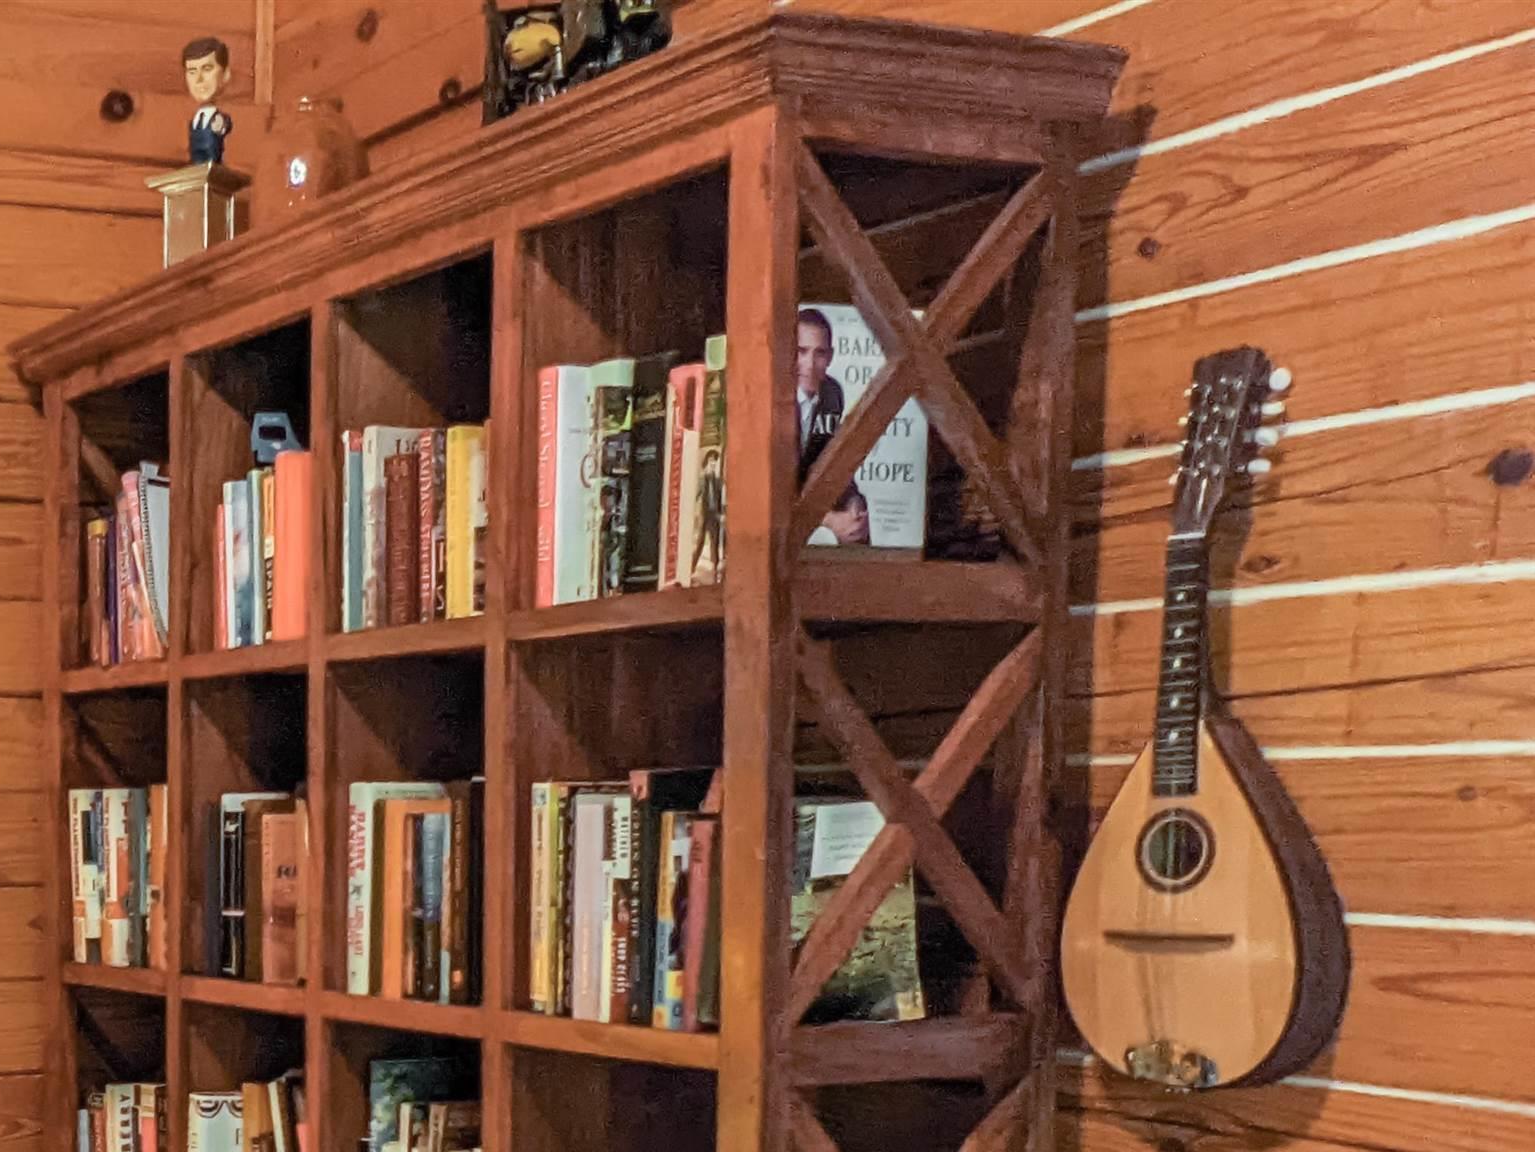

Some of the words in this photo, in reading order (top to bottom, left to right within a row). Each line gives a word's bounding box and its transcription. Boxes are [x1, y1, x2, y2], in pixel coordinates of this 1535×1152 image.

[837, 336, 881, 357] BAR
[859, 462, 914, 483] HOPE
[120, 1093, 132, 1152] BERRY
